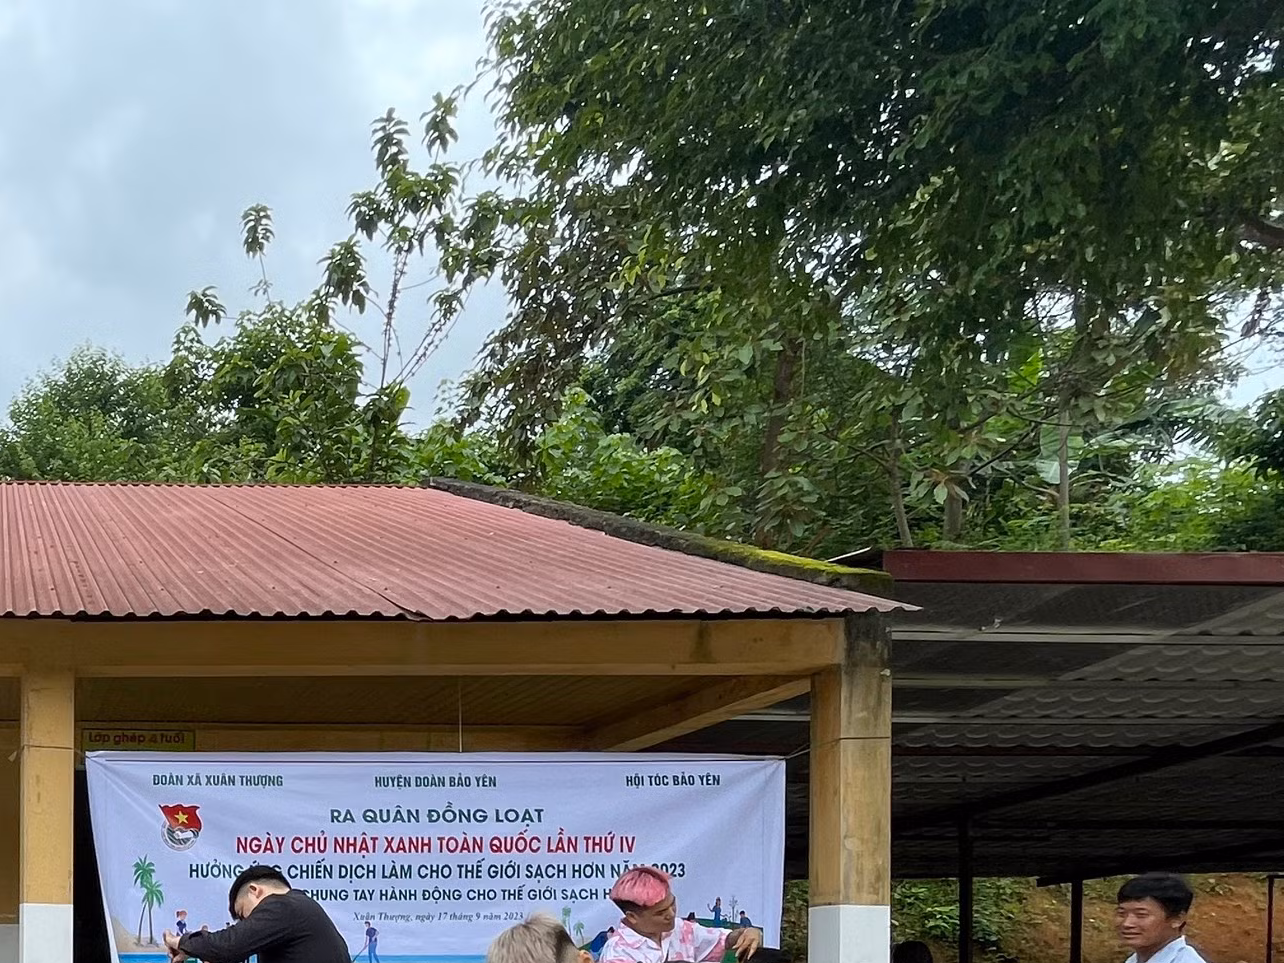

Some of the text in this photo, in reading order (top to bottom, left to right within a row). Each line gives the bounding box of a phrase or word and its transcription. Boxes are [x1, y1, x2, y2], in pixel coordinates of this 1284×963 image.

[152, 773, 284, 789] ĐOÀN XÃ XUÂN THƯỢNG
[374, 774, 412, 790] HUYỆN
[449, 773, 472, 788] BẢO
[474, 774, 497, 788] YÊN
[625, 772, 721, 789] HỘI TÓC BẢO YÊN
[330, 801, 545, 827] RA QUÂN ĐỒNG LOẠT
[236, 827, 636, 859] NGÀY CHỦ NHẬT XANH TOÀN QUỐC LẦN THỨ IV
[189, 859, 243, 879] HƯỞNG
[287, 858, 333, 879] CHIẾN
[338, 863, 376, 884] DỊCH
[381, 860, 412, 879] LÀM
[417, 863, 452, 879] CHO
[457, 858, 486, 879] THẾ
[487, 860, 521, 879] GIỚI
[525, 863, 567, 884] SẠCH
[572, 861, 605, 879] HƠN
[610, 860, 646, 879] NĂ
[353, 889, 376, 901] TAY
[379, 886, 417, 901] HÀNH
[422, 886, 462, 904] ĐỘNG
[466, 889, 497, 901] CHO
[501, 884, 526, 901] THẾ
[527, 887, 557, 901] GIỚI
[562, 888, 599, 904] SẠCH
[353, 911, 375, 921] Xuân
[415, 912, 435, 923] ngày
[437, 911, 448, 921] 17
[449, 911, 474, 923] tháng
[475, 911, 481, 921] 9
[483, 911, 502, 921] năm
[503, 911, 524, 921] 2023
